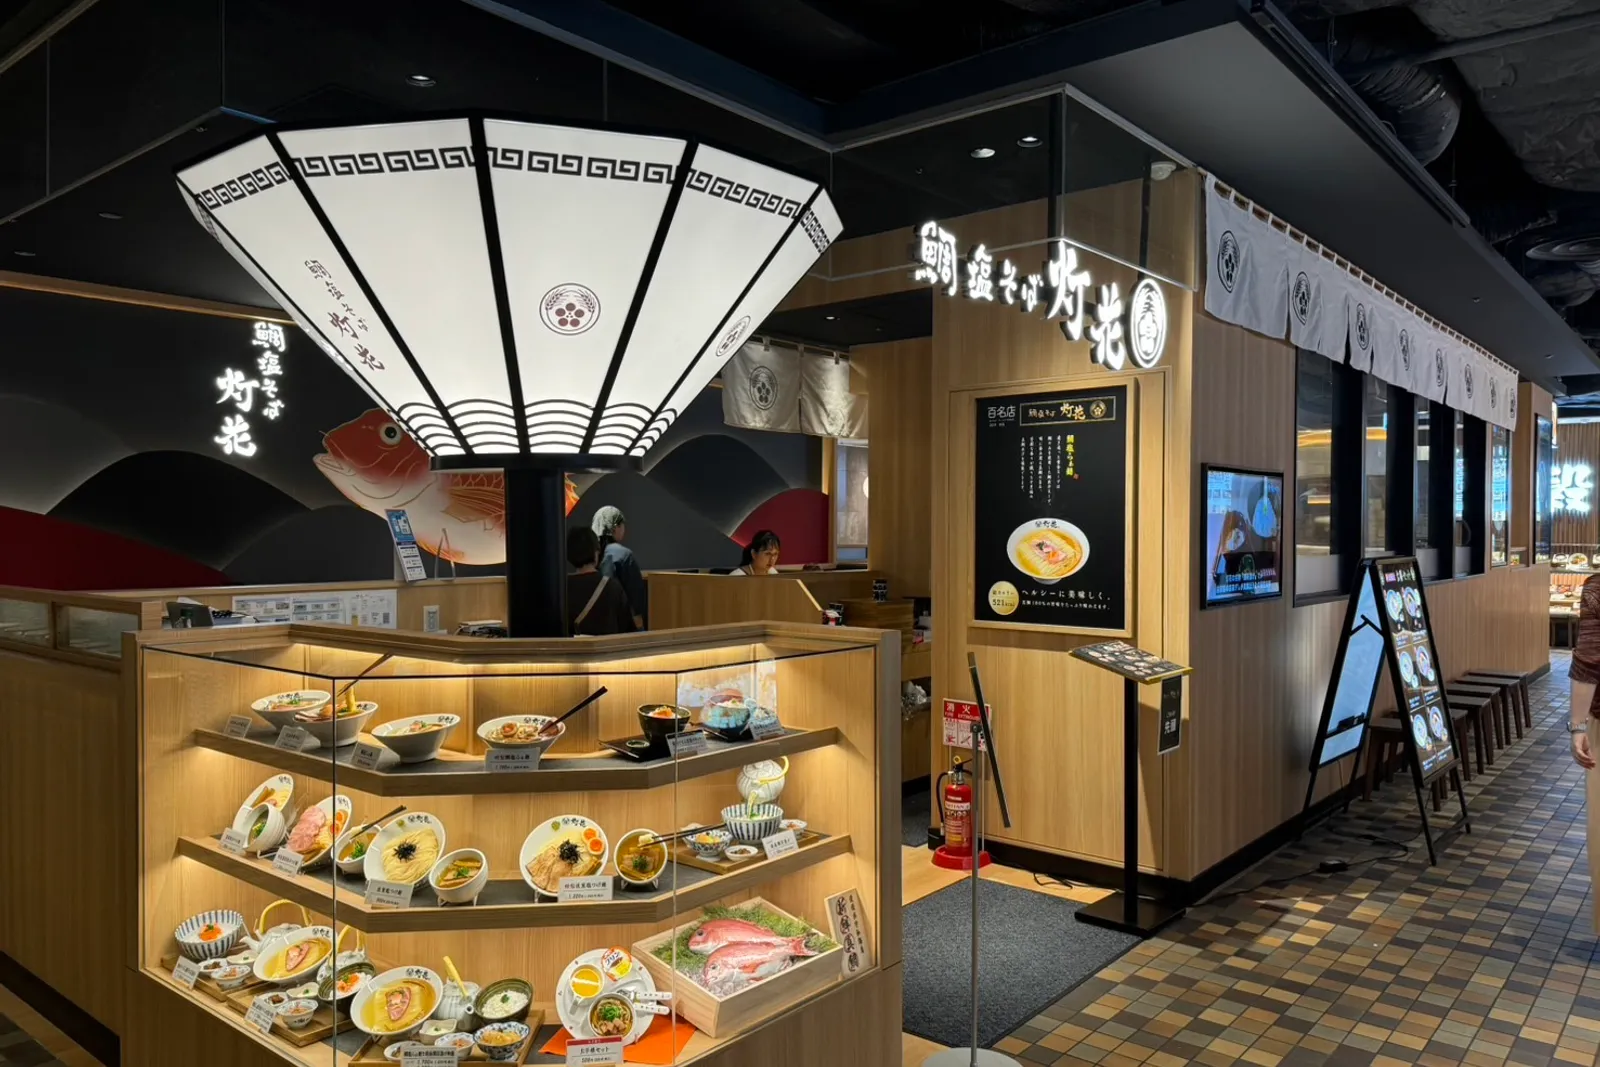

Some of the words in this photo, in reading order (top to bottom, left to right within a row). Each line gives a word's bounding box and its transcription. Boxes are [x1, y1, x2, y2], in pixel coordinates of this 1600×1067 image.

[304, 259, 370, 333] 鯛塩そば
[914, 221, 1044, 313] 鯛塩そば
[1047, 240, 1126, 371] 灯花
[252, 321, 286, 421] 鯛塩そば
[327, 311, 385, 371] 灯花
[214, 367, 260, 457] 灯花
[987, 405, 1017, 418] 百名店
[1060, 402, 1086, 420] 灯花
[1021, 589, 1111, 601] ヘルシーに美味しく。
